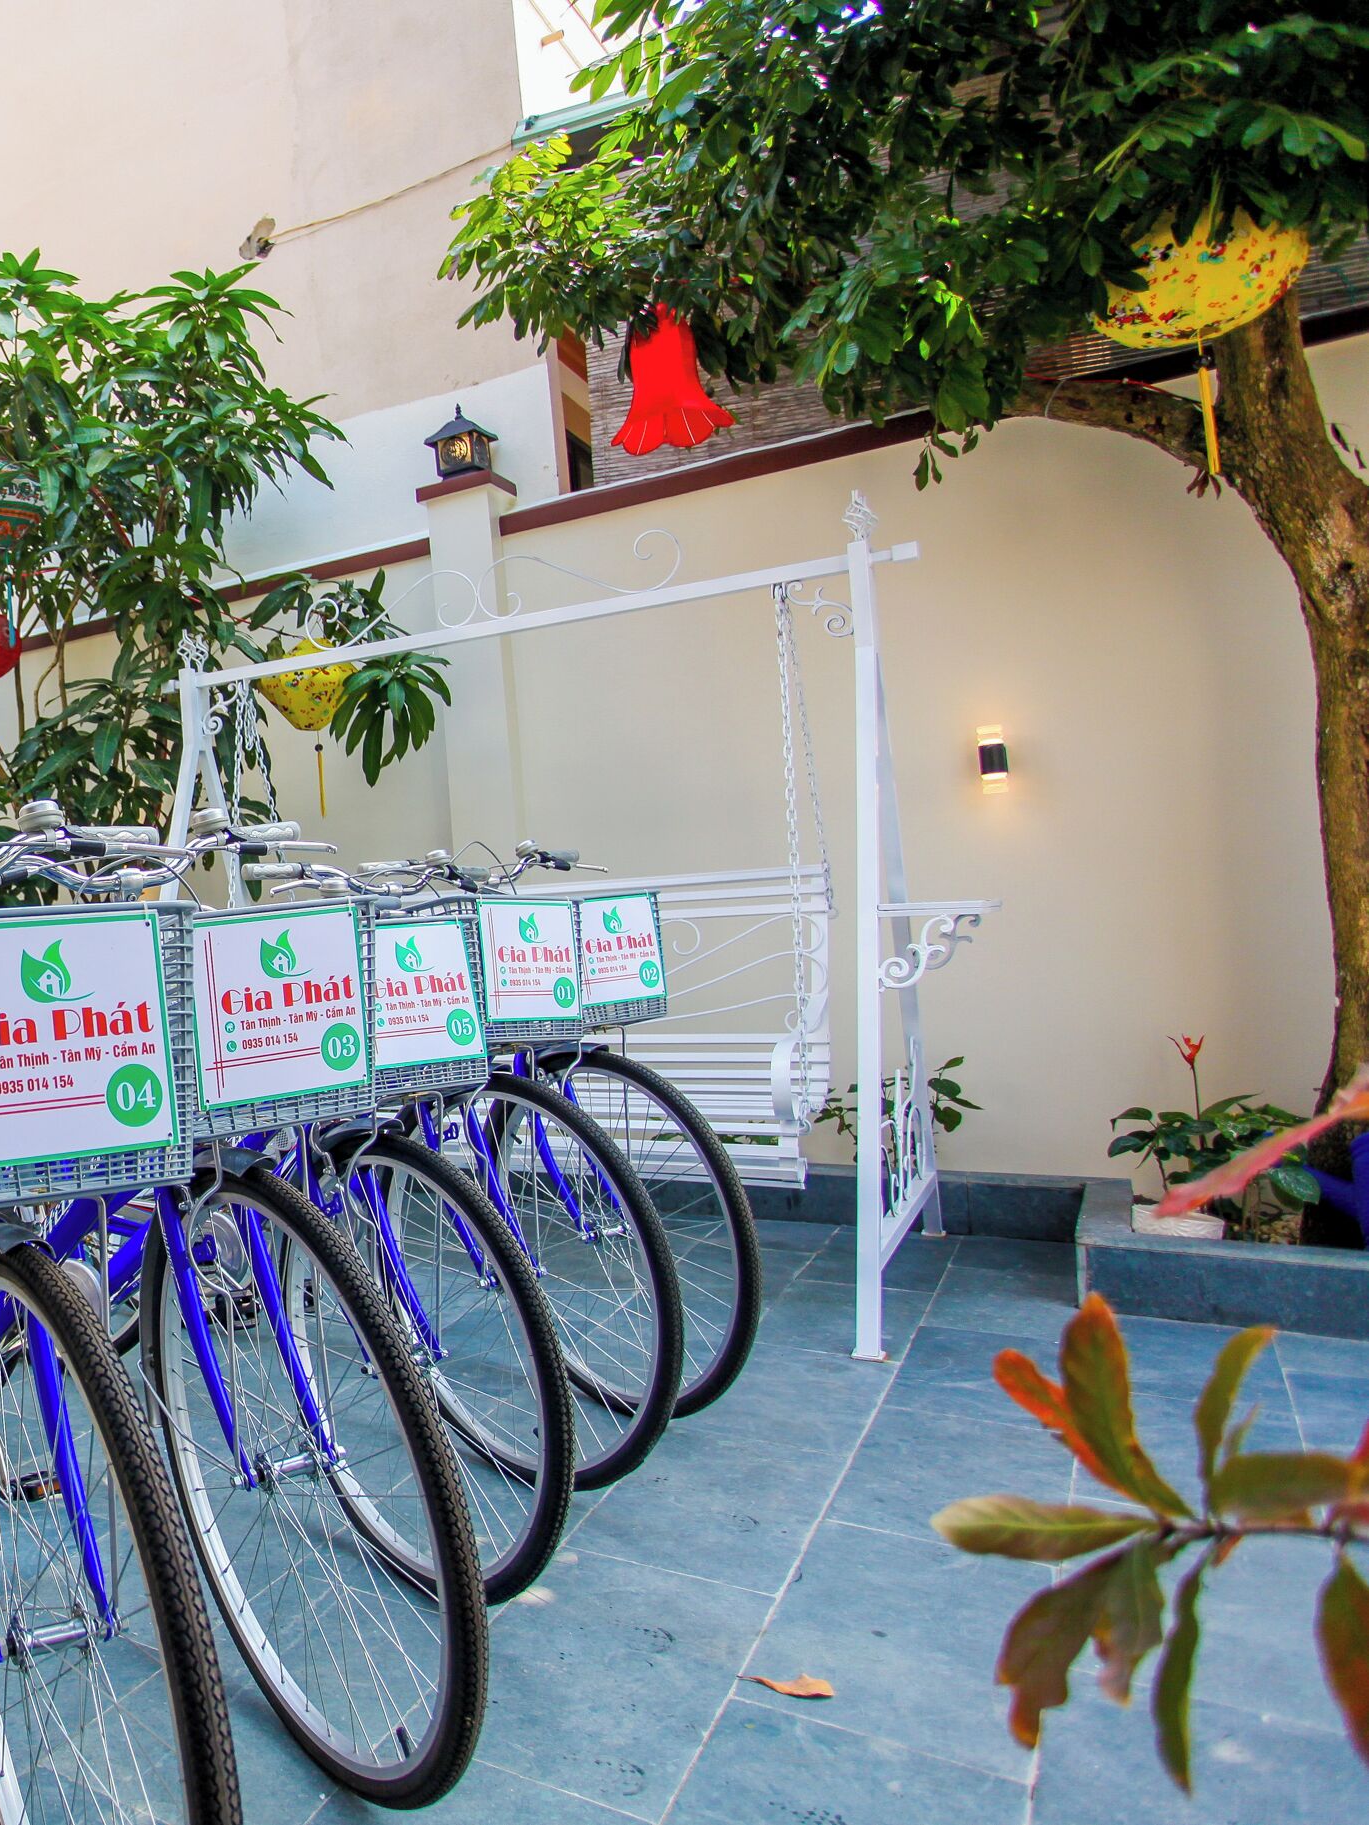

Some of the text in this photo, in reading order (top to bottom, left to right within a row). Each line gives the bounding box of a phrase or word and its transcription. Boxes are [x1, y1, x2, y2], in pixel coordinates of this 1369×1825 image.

[585, 933, 654, 953] Gia Phát
[498, 946, 571, 963] Gia Phát
[414, 972, 467, 995] Phát
[643, 968, 657, 981] 02
[221, 975, 355, 1015] Gia Phát
[557, 985, 572, 1000] 01
[386, 1002, 397, 1011] Tân
[421, 998, 431, 1007] Tân
[52, 1001, 154, 1040] Phát
[241, 1019, 256, 1031] Tân
[258, 1016, 281, 1030] Thịnh
[289, 1012, 304, 1024] Tân
[306, 1010, 318, 1023] Mỹ
[346, 1006, 356, 1016] An
[388, 1014, 429, 1025] 0935 014 154
[451, 1017, 473, 1036] 05
[242, 1033, 298, 1049] 0935 014 154
[328, 1035, 356, 1059] 03
[17, 1052, 49, 1070] Thịnh
[60, 1049, 81, 1064] Tân
[85, 1046, 101, 1062] Mỹ
[113, 1041, 139, 1058] Cẩm
[142, 1043, 155, 1055] An
[28, 1078, 49, 1092] 014
[52, 1075, 74, 1089] 154
[116, 1079, 156, 1111] 04
